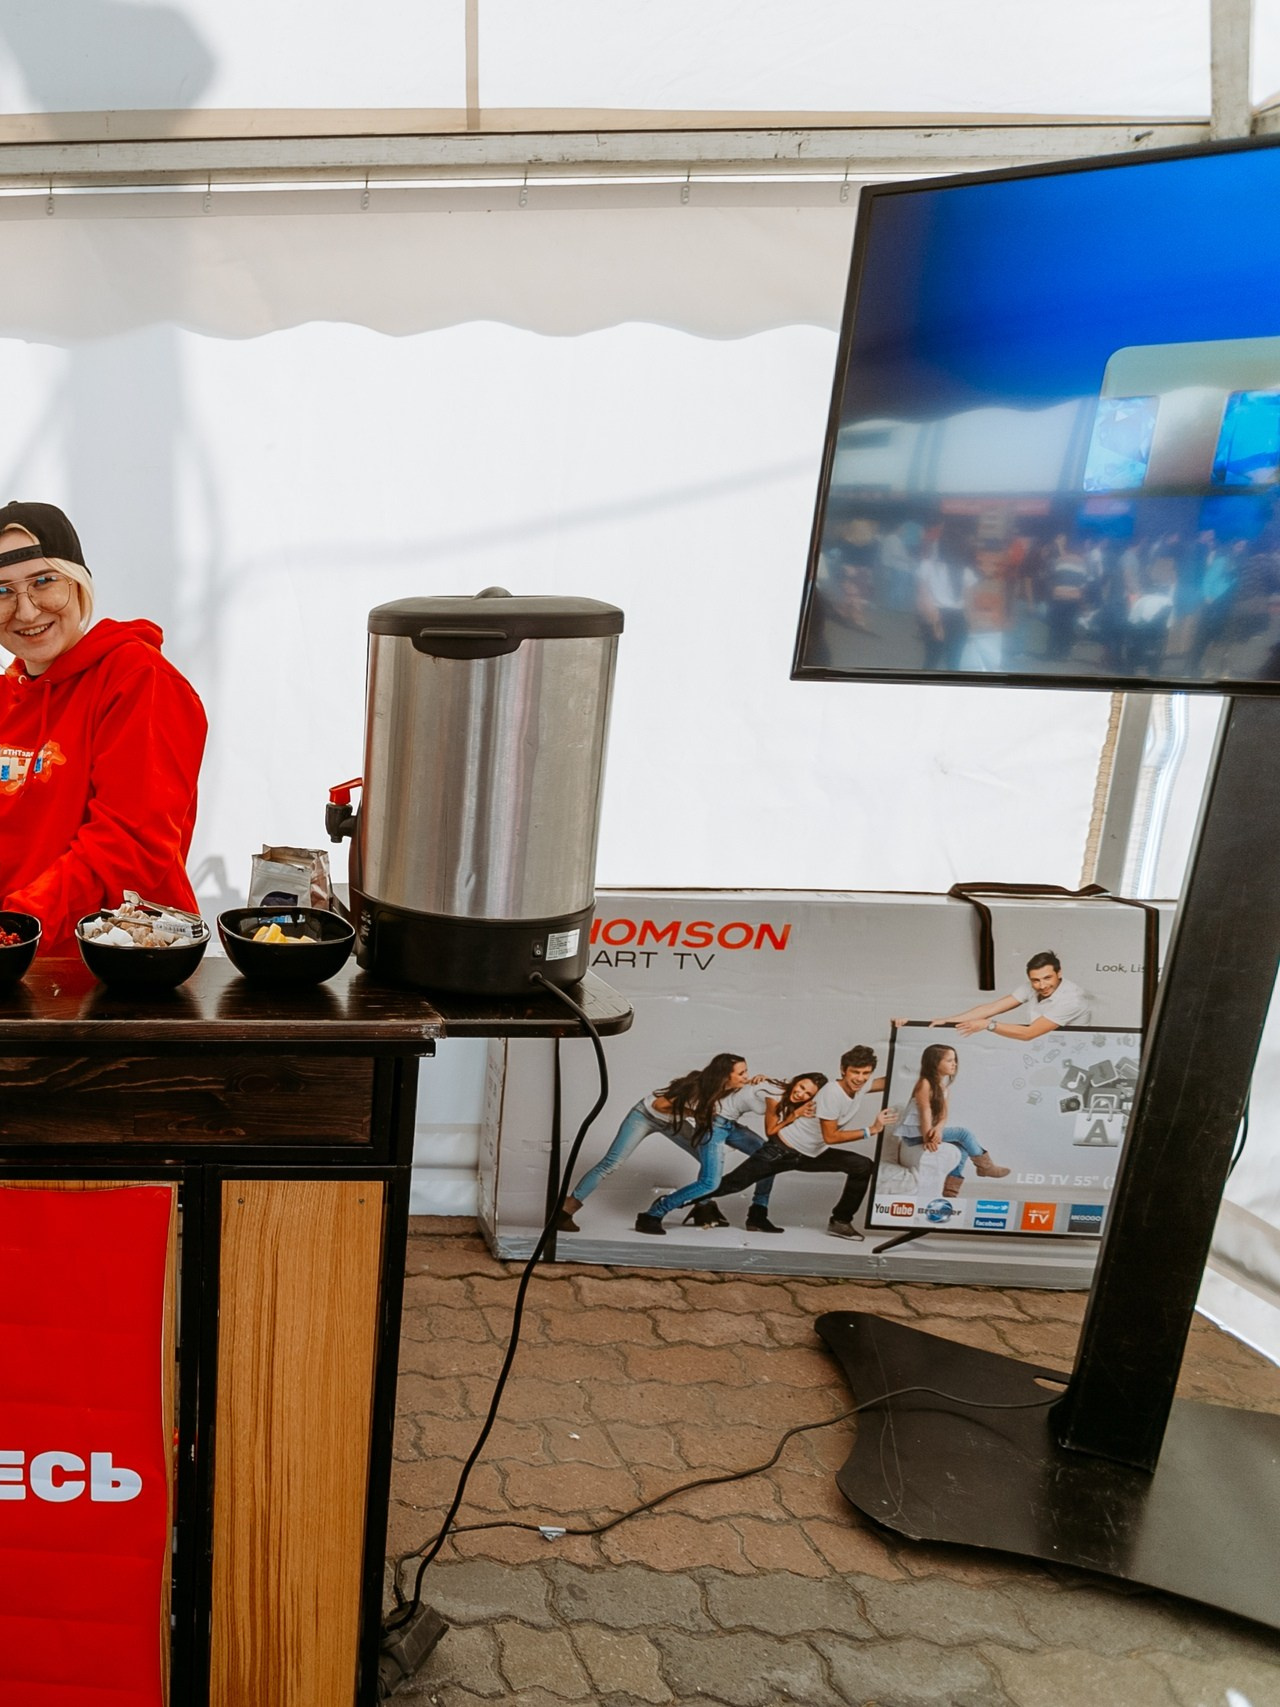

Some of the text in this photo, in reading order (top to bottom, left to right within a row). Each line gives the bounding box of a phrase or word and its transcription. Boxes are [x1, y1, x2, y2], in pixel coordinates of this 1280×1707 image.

[588, 950, 715, 971] ART TV
[1095, 963, 1127, 974] Look,
[1016, 1173, 1045, 1184] LED
[1049, 1174, 1070, 1185] TV
[1073, 1175, 1099, 1187] 55"
[975, 1219, 1004, 1228] facebook
[1028, 1213, 1050, 1225] TV
